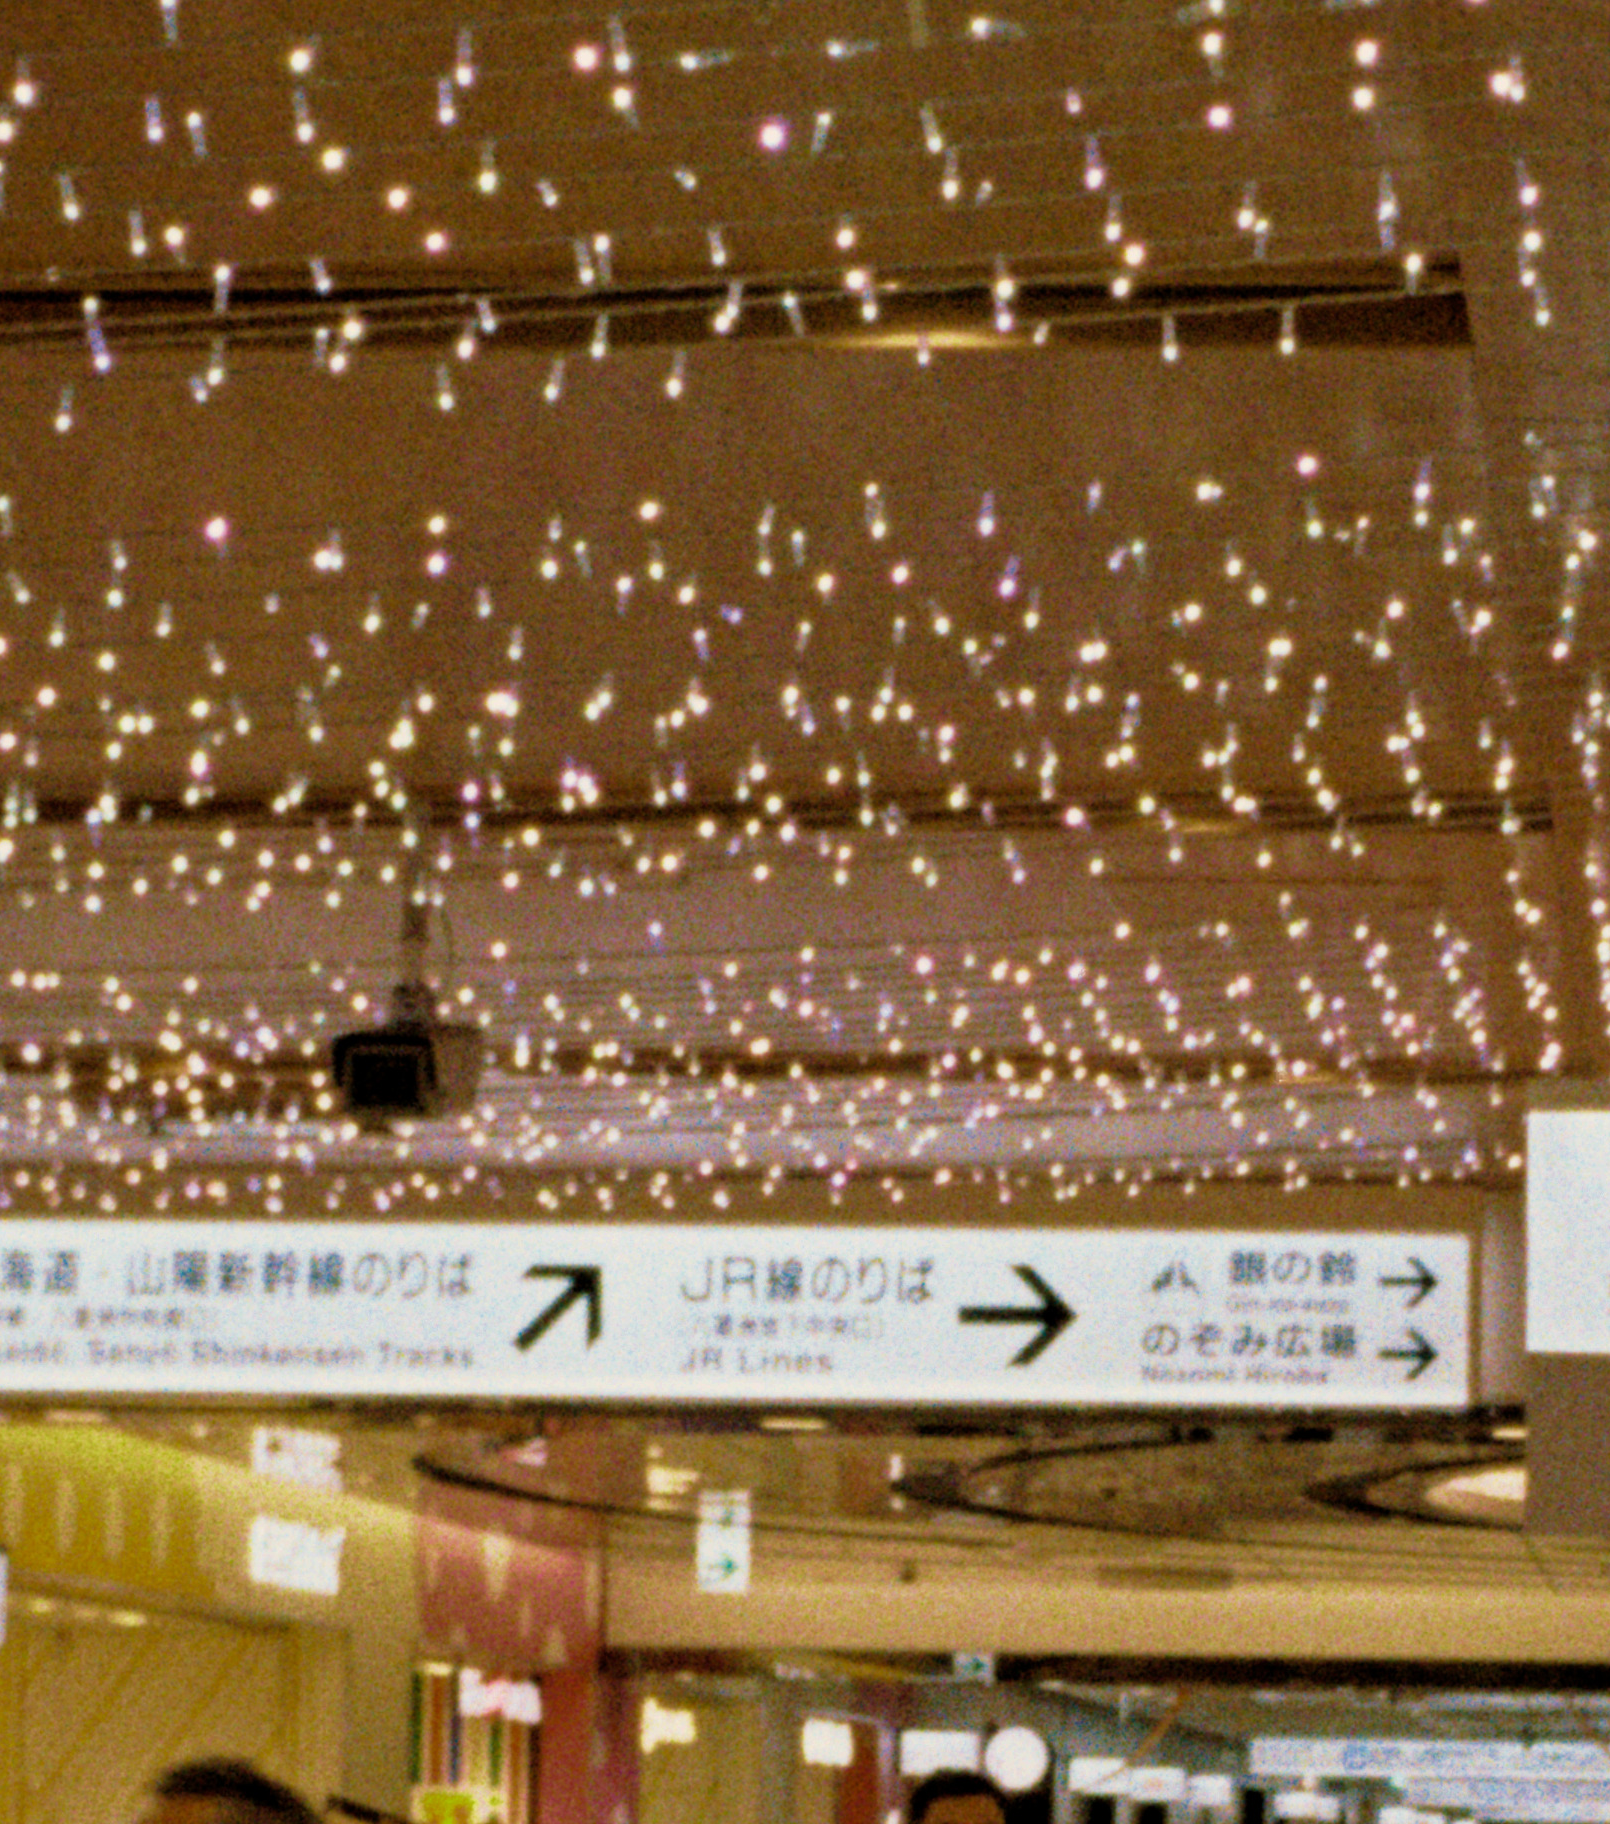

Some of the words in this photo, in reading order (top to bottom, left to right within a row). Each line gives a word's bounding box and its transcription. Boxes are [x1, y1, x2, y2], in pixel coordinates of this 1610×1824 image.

[678, 1254, 937, 1307] JR線のりば
[1228, 1249, 1359, 1287] 銀の鈴
[1140, 1322, 1358, 1359] のぞみ広場
[680, 1346, 723, 1374] JR
[737, 1346, 834, 1374] Lines
